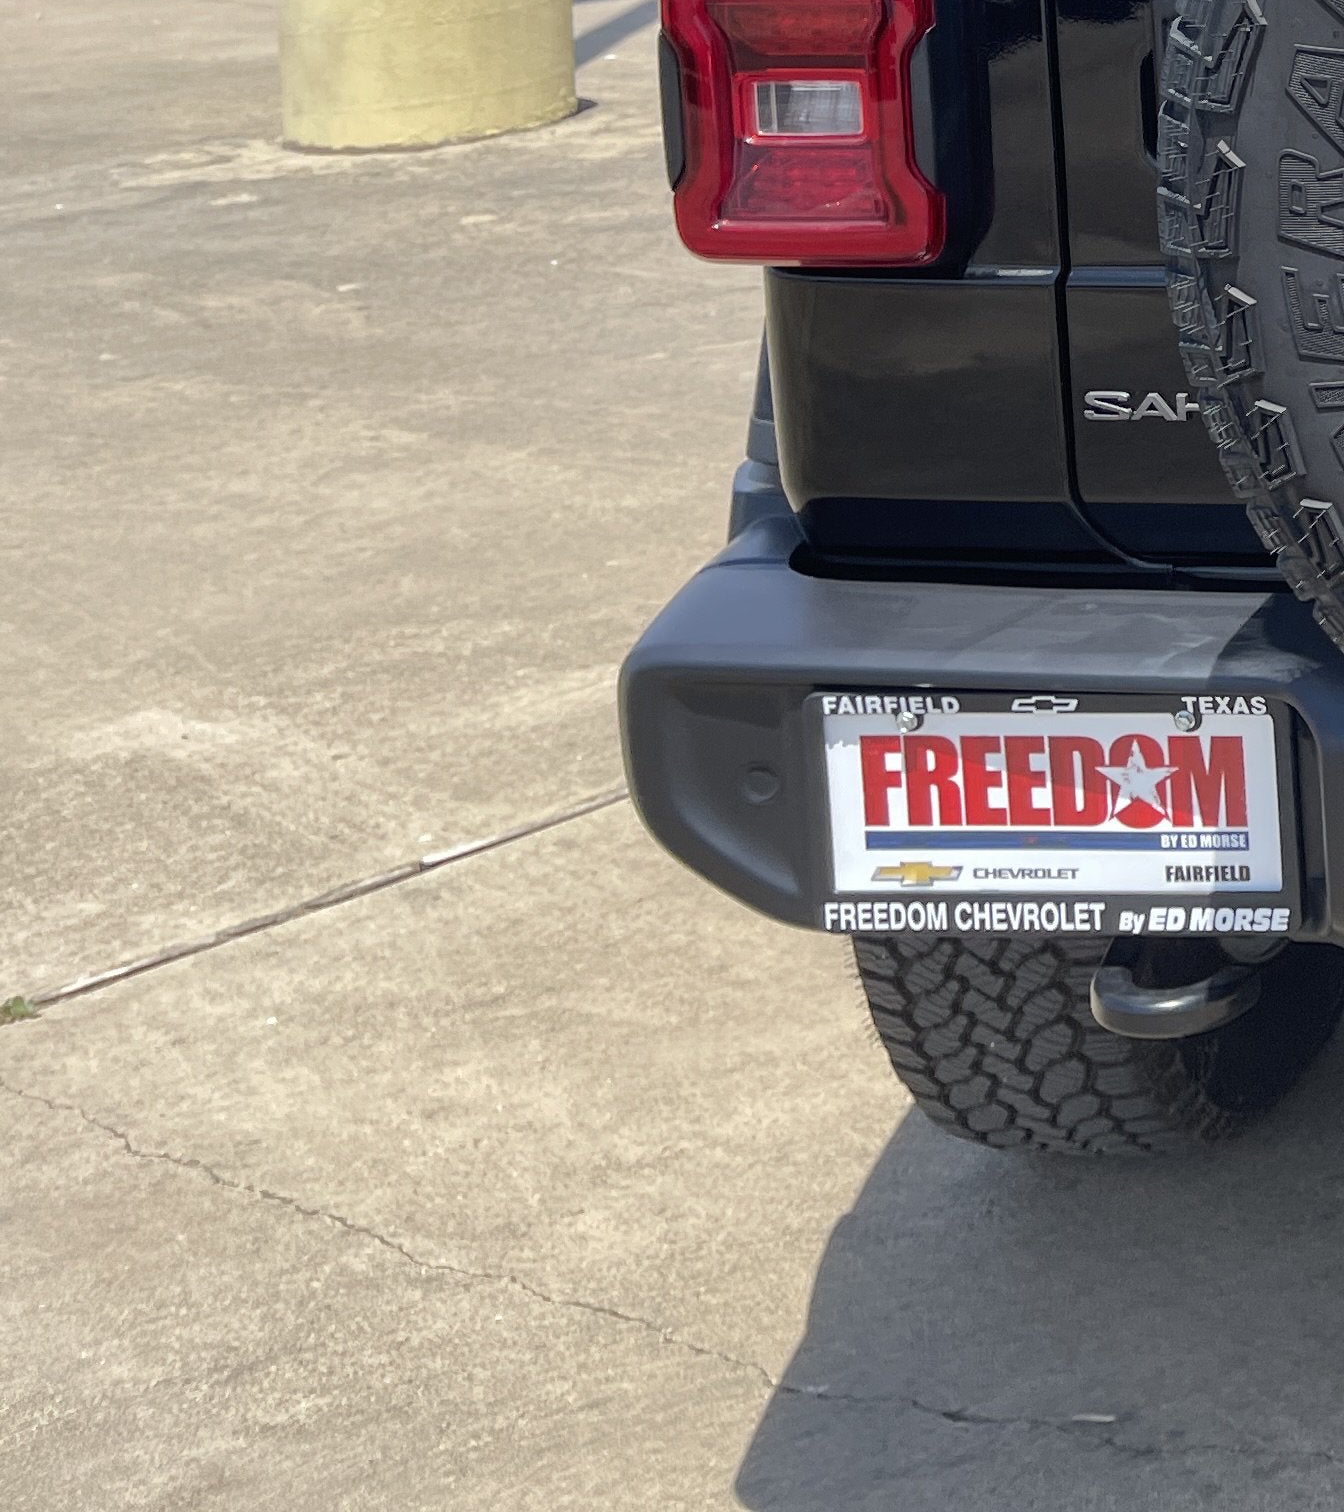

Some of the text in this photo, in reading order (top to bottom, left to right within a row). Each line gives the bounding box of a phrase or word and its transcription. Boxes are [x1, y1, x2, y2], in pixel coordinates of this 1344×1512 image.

[822, 695, 1267, 715] FAIRFIELD TEXAS
[860, 734, 1249, 829] FREEDOM
[1160, 834, 1246, 849] BY ED MORSE
[972, 868, 1080, 881] CHEVROLET
[1165, 865, 1251, 883] FAIRFIELD
[824, 901, 1290, 935] FREEDOM CHEVROLET By ED MORSE
